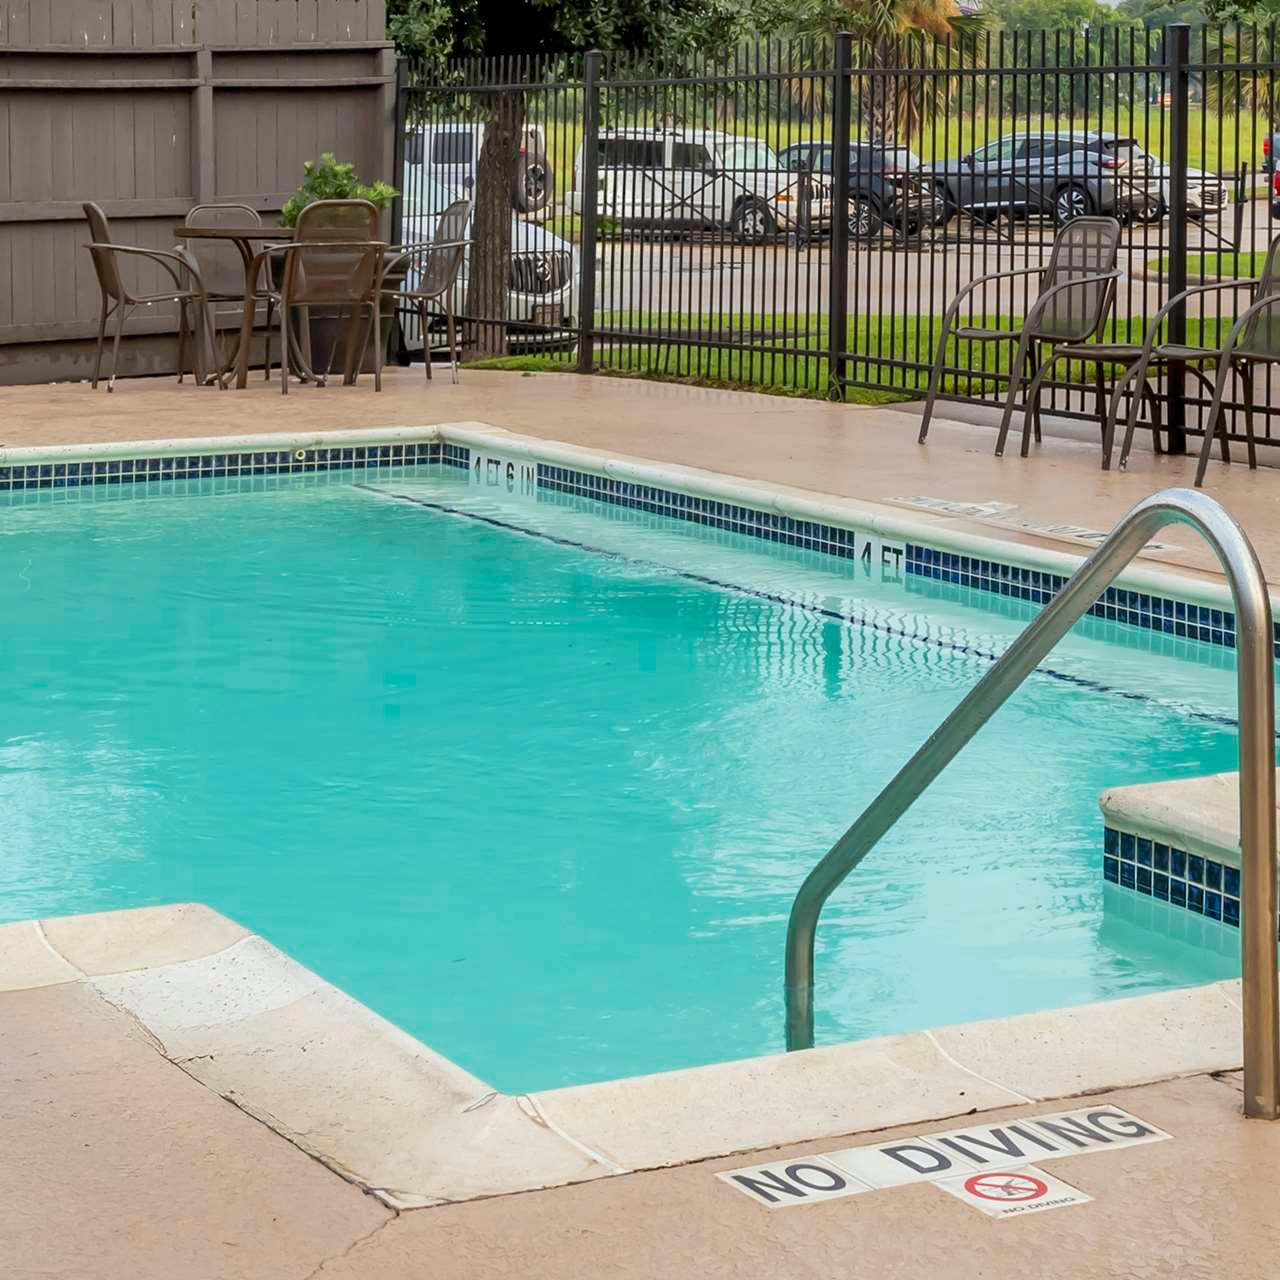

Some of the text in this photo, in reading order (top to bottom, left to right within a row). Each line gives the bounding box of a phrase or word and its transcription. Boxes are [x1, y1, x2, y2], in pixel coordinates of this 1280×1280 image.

[520, 464, 535, 483] IN
[881, 545, 904, 570] FT
[731, 1110, 1156, 1203] NO DIVING
[1001, 1196, 1076, 1214] NO DIVING
